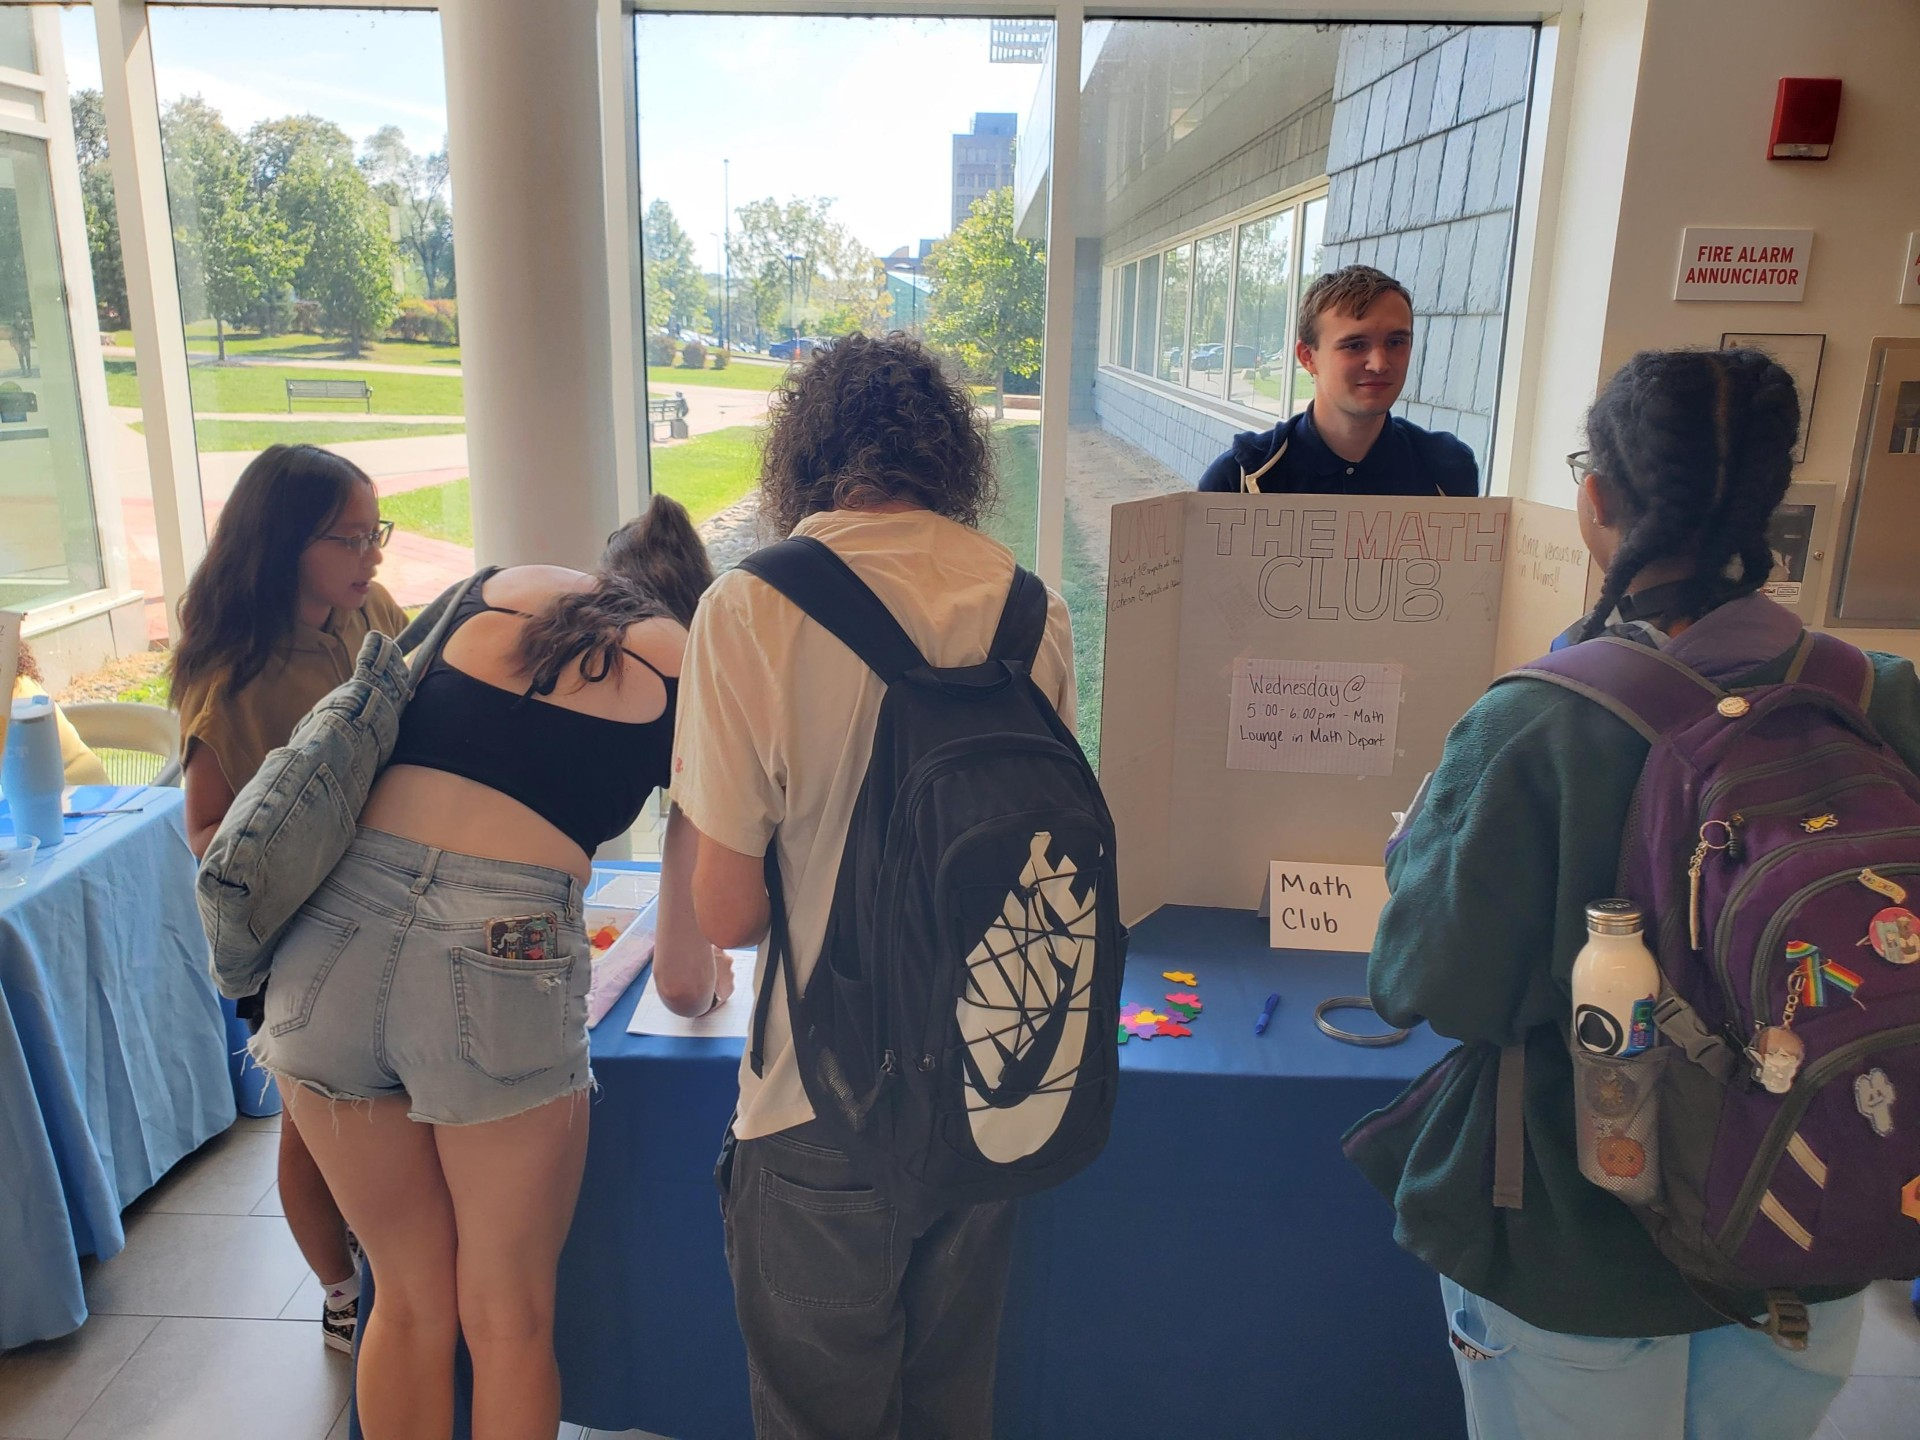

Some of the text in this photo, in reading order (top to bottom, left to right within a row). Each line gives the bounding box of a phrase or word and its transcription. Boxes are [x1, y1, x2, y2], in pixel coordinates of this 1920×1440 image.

[1697, 246, 1794, 263] FIRE ALARM
[1685, 267, 1799, 285] ANNUNCIATOR
[1206, 508, 1507, 562] THE MATH
[1257, 555, 1444, 622] CLUB
[1249, 673, 1340, 707] Wednesday
[1353, 709, 1384, 724] Math
[1240, 725, 1284, 749] Lounge
[1292, 734, 1303, 743] in
[1310, 728, 1343, 743] Math
[1281, 873, 1352, 899] Math
[1282, 907, 1338, 933] Club
